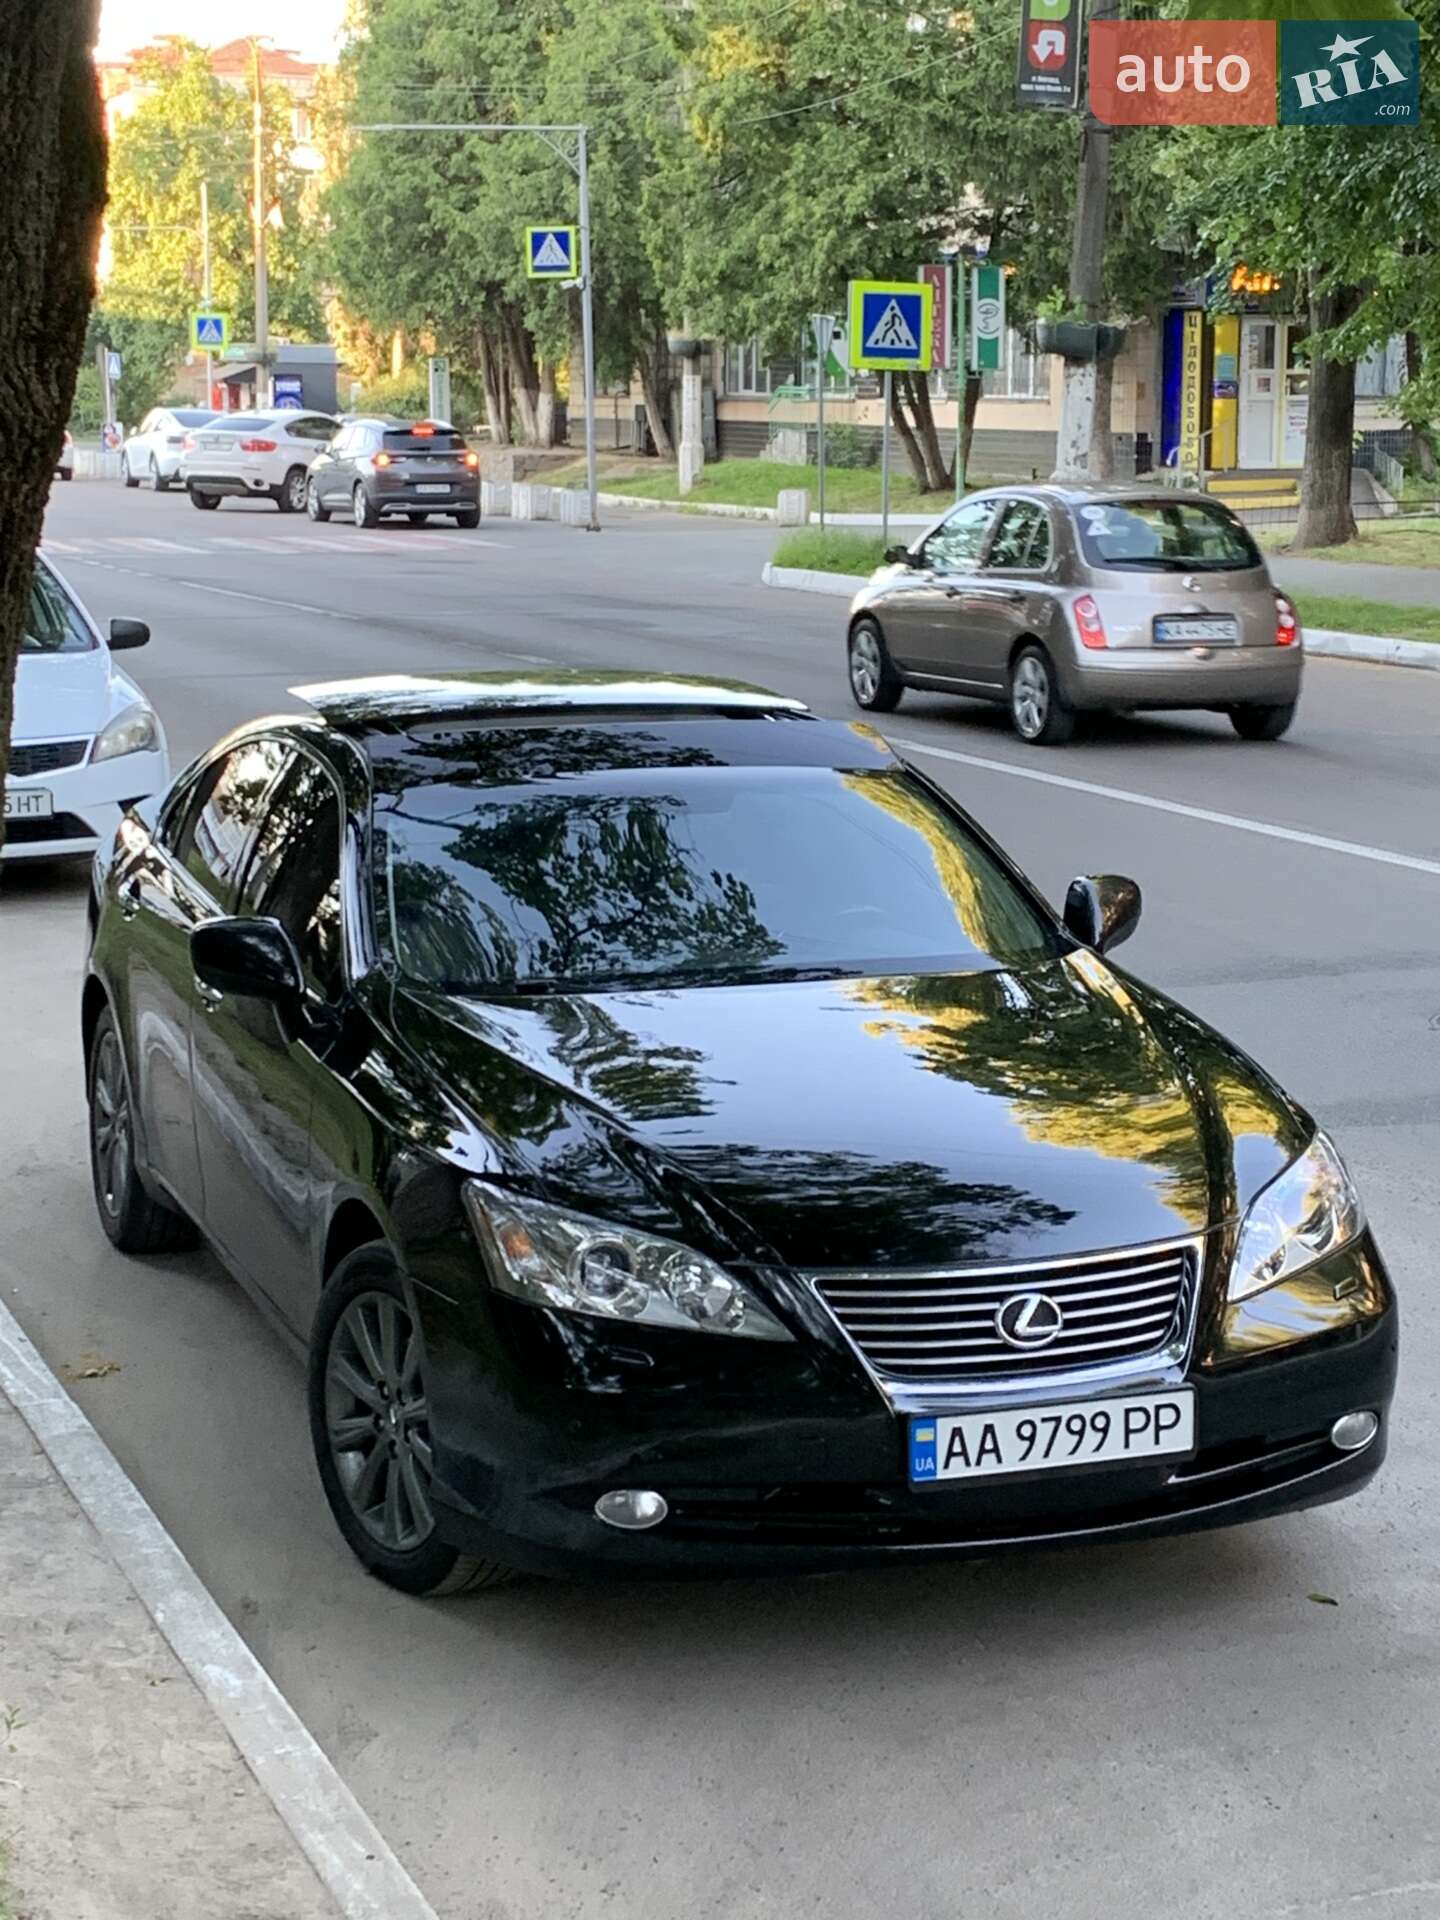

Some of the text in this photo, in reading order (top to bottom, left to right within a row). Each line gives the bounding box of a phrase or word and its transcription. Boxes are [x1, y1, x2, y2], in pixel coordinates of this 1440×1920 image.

[17, 795, 44, 813] HT
[943, 1402, 1182, 1470] AA 9799 PP
[914, 1457, 935, 1472] UA
